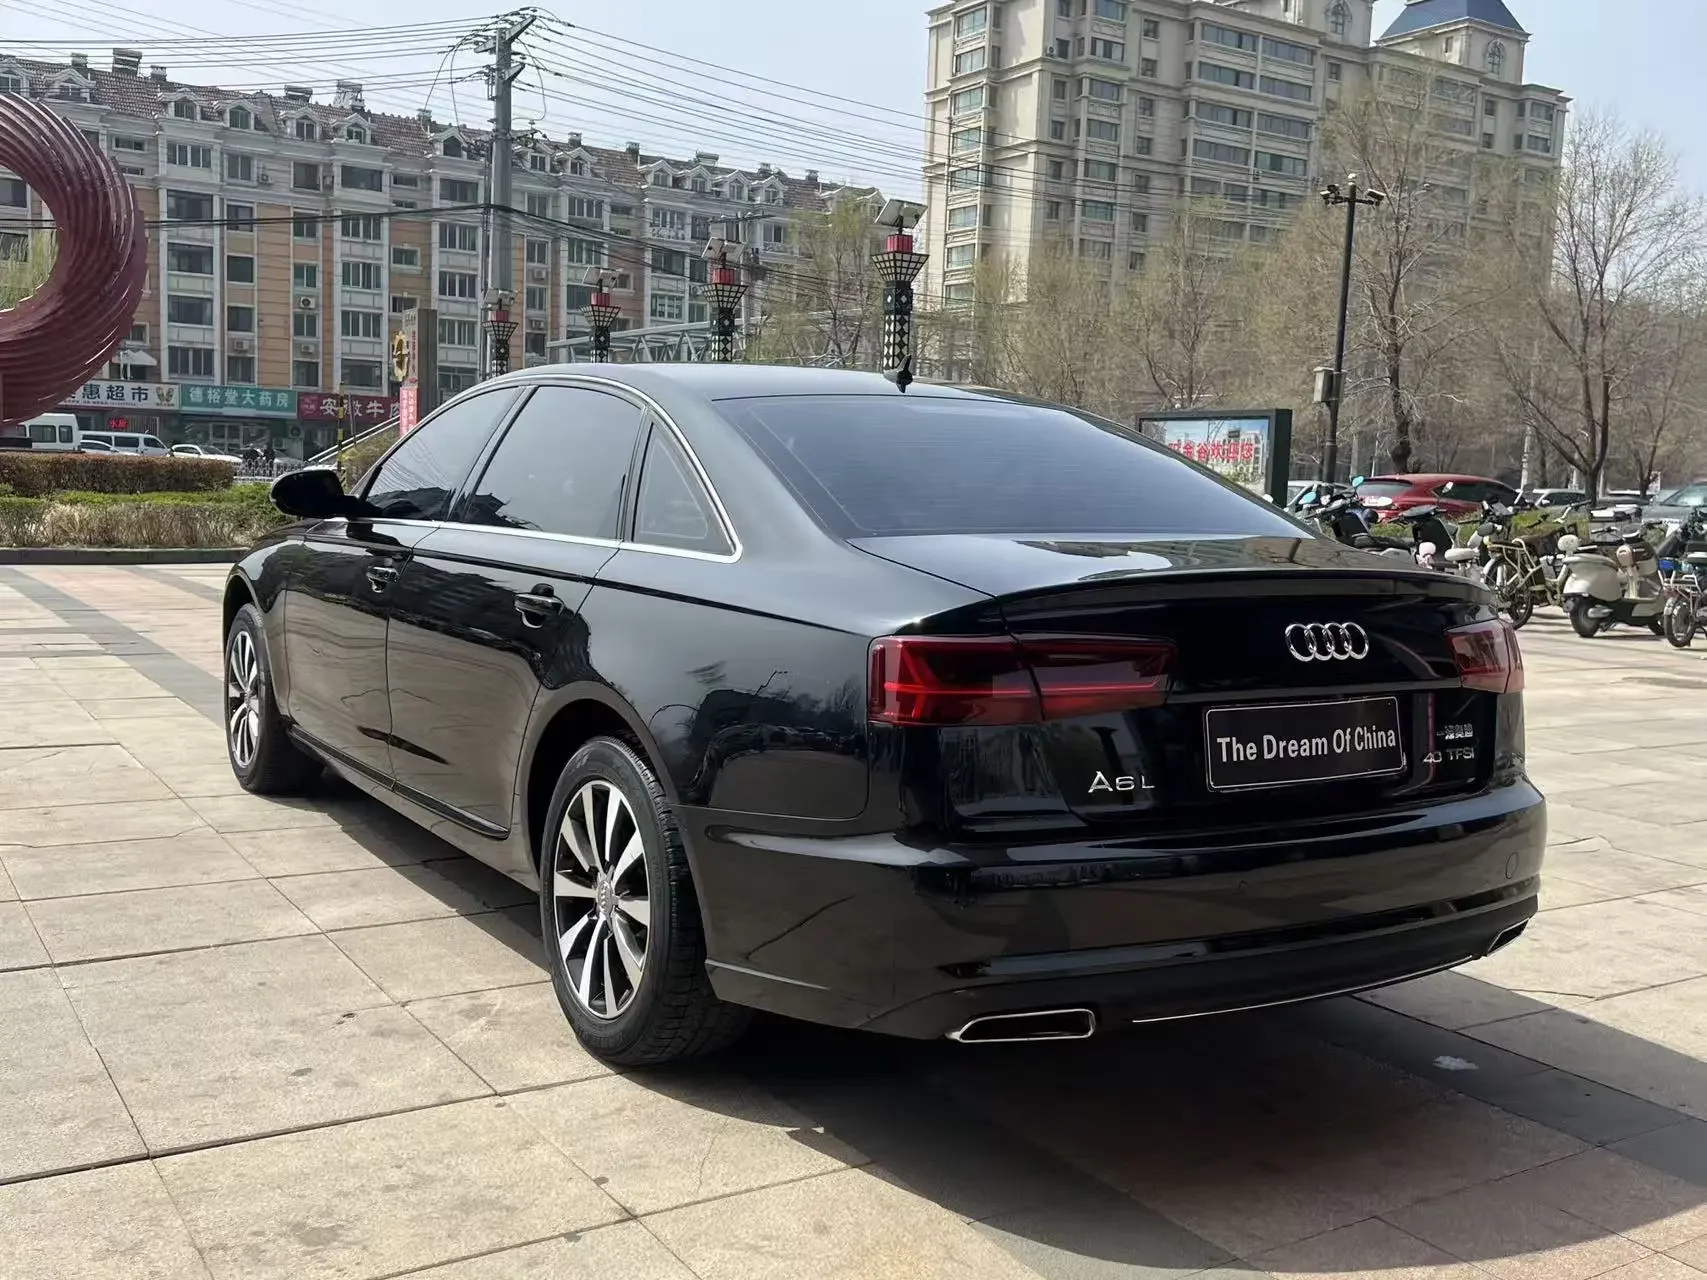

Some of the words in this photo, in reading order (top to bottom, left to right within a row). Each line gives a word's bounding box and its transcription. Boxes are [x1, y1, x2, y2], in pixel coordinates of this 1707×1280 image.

[70, 384, 149, 402] 惠超市
[189, 386, 289, 408] 德裕堂大药房
[1216, 737, 1258, 762] The
[1262, 734, 1328, 760] Dream
[1332, 727, 1351, 754] Of
[1354, 725, 1396, 751] China
[1423, 751, 1443, 763] 40
[1445, 746, 1475, 760] TFSI
